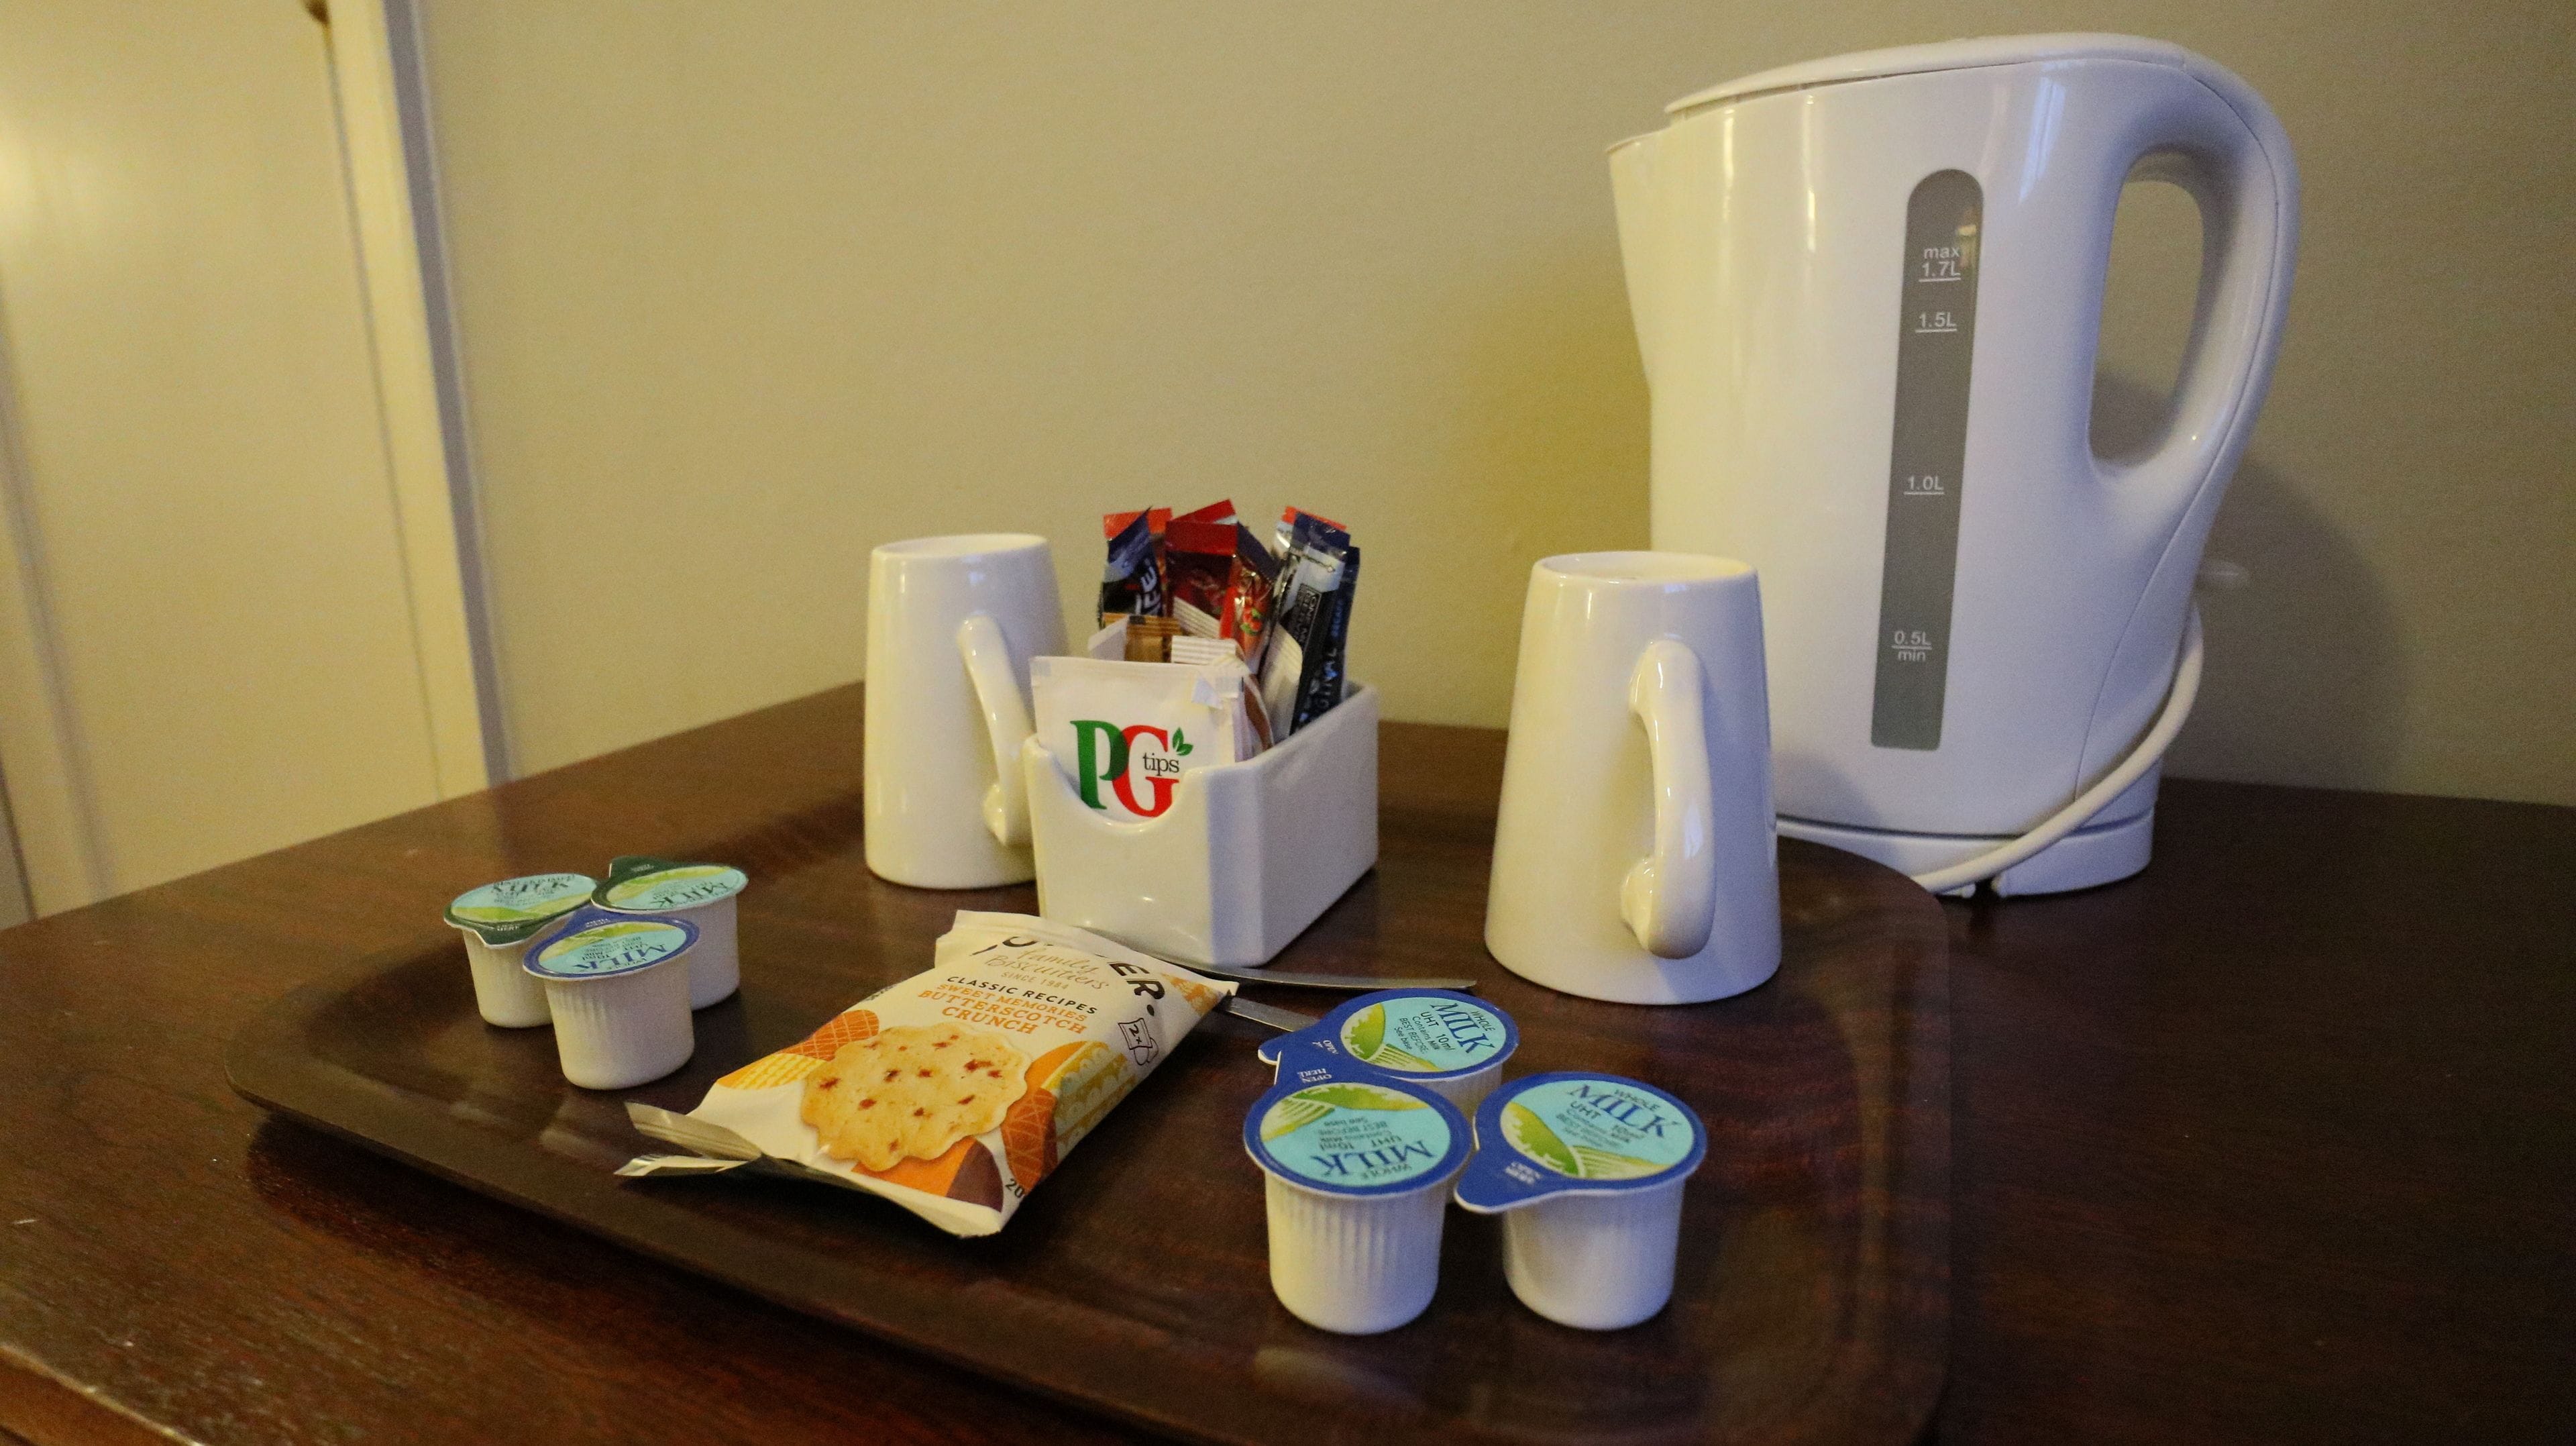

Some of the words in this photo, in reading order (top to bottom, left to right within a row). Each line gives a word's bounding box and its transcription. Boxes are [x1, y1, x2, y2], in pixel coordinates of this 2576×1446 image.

[1923, 246, 1960, 259] max
[1921, 261, 1961, 277] 1.7L
[1919, 311, 1957, 327] 1.5L
[1907, 475, 1944, 490] 1.0L
[1894, 630, 1932, 645] 0.5L
[1898, 650, 1926, 662] min
[1069, 720, 1180, 818] PG
[1142, 752, 1180, 776] tips
[572, 943, 668, 970] MILK
[1001, 972, 1036, 982] SINCE
[936, 983, 997, 1000] SWEET
[996, 996, 1088, 1022] MEMORIES
[947, 976, 1018, 995] CLASSIC
[1022, 990, 1098, 1015] RECIPES
[917, 990, 1088, 1035] BUTTERSCOTCH
[941, 1006, 1040, 1035] CRUNCH
[1399, 1017, 1413, 1031] BEST
[1470, 1011, 1496, 1033] WHOLE
[1412, 1015, 1432, 1041] Contains
[1420, 1011, 1440, 1027] UHT
[1435, 1033, 1456, 1051] 10ml
[1430, 1002, 1496, 1054] MILK
[1567, 1084, 1680, 1138] MILK
[1570, 1100, 1601, 1119] UHT
[1309, 1140, 1434, 1176] MILK
